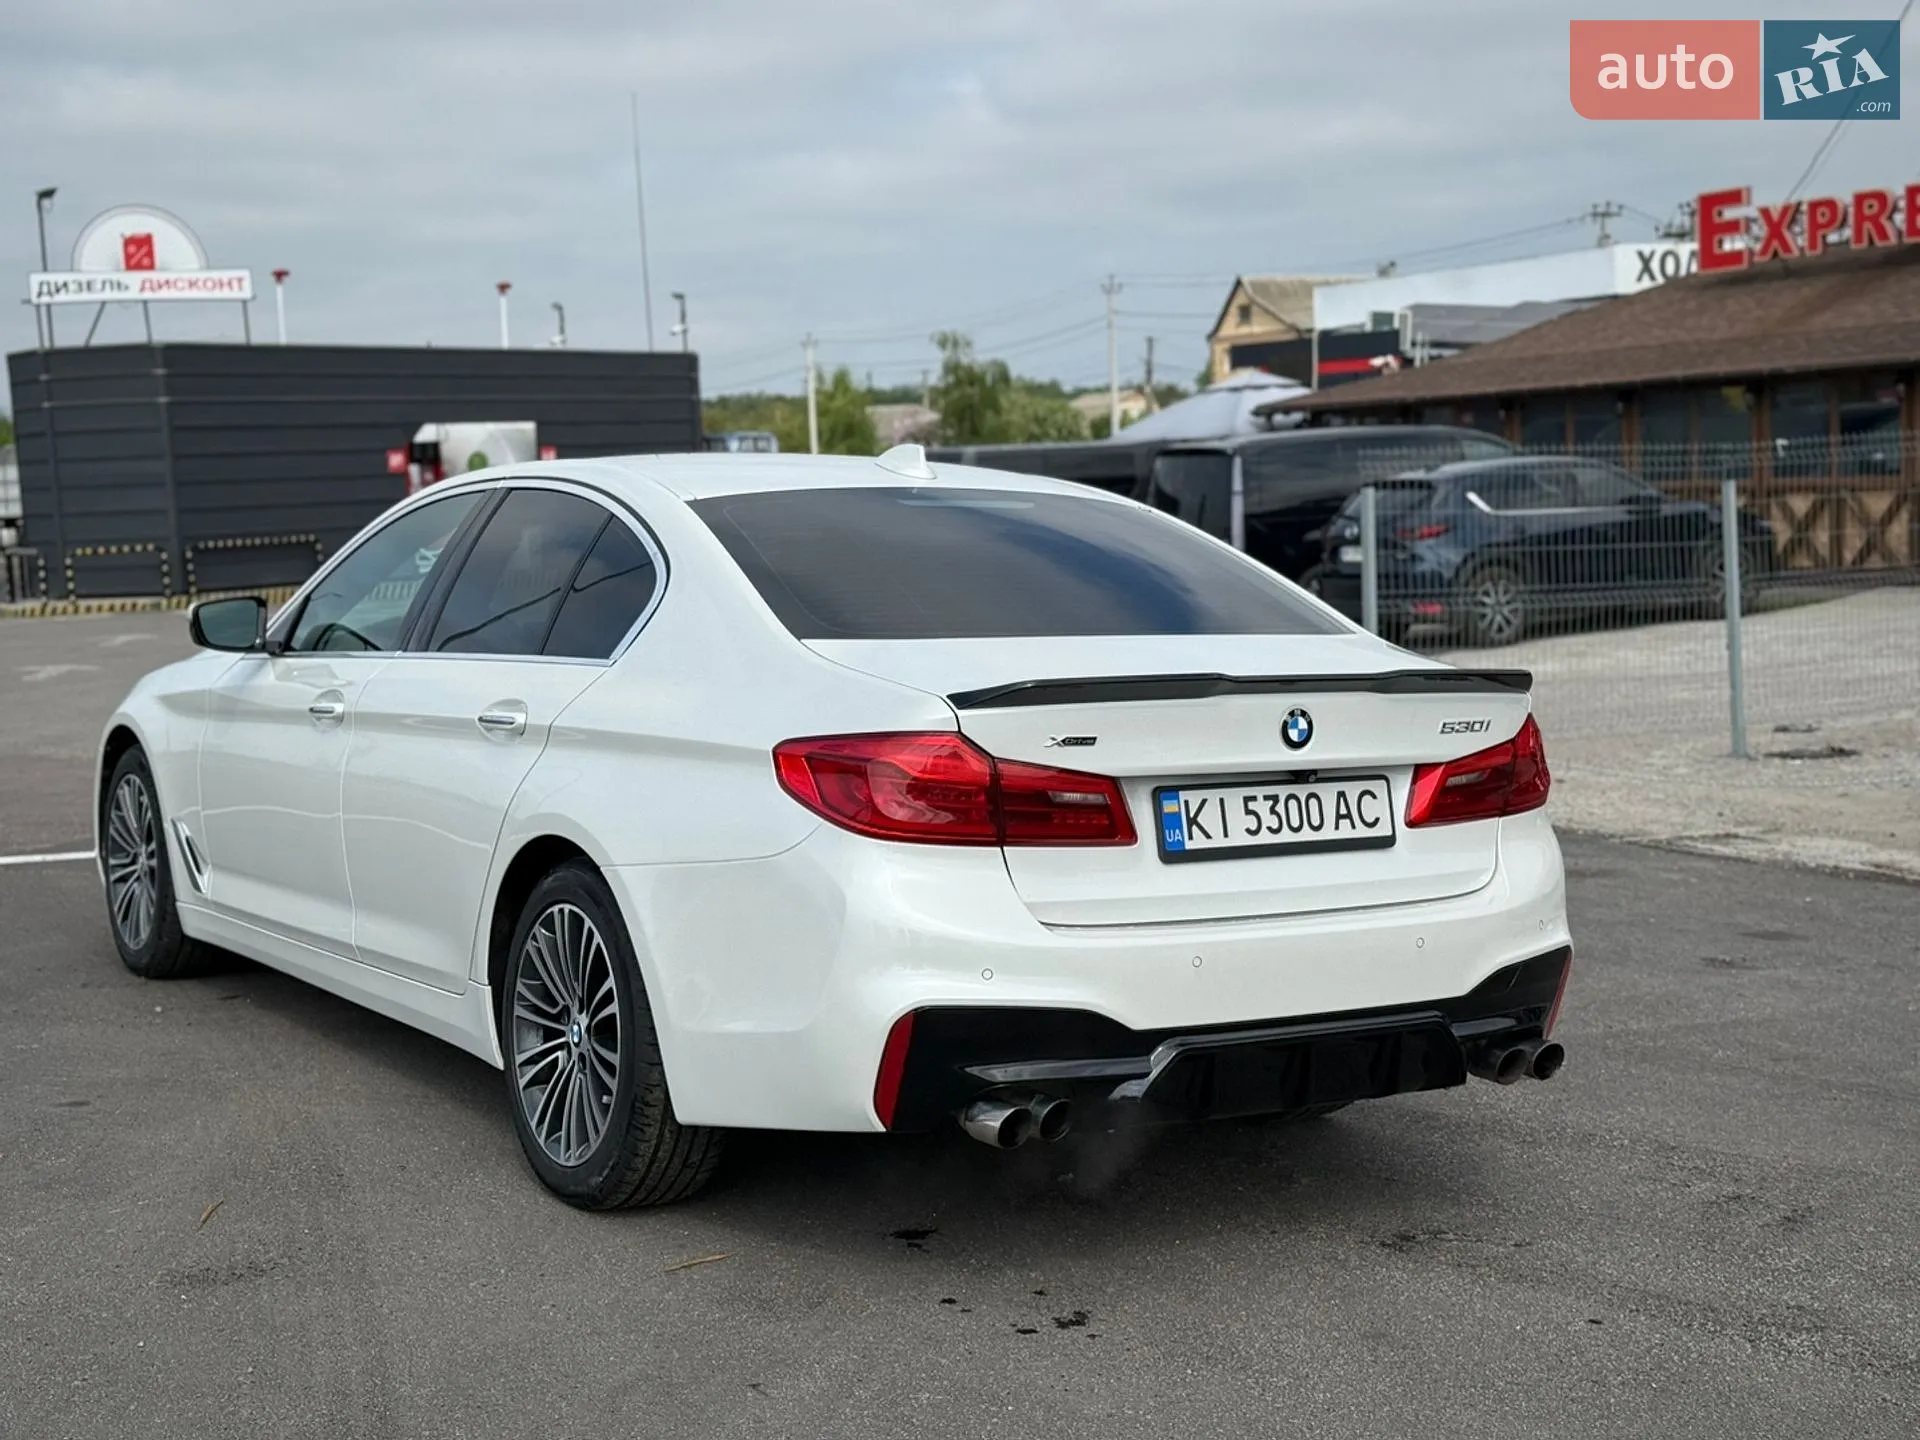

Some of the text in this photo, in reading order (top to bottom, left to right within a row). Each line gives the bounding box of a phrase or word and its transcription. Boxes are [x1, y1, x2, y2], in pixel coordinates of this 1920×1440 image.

[36, 276, 246, 298] ДИЗЕЛЬ ДИСКОНТ
[1183, 788, 1381, 841] KI 5300 AC
[1165, 828, 1183, 843] UA
